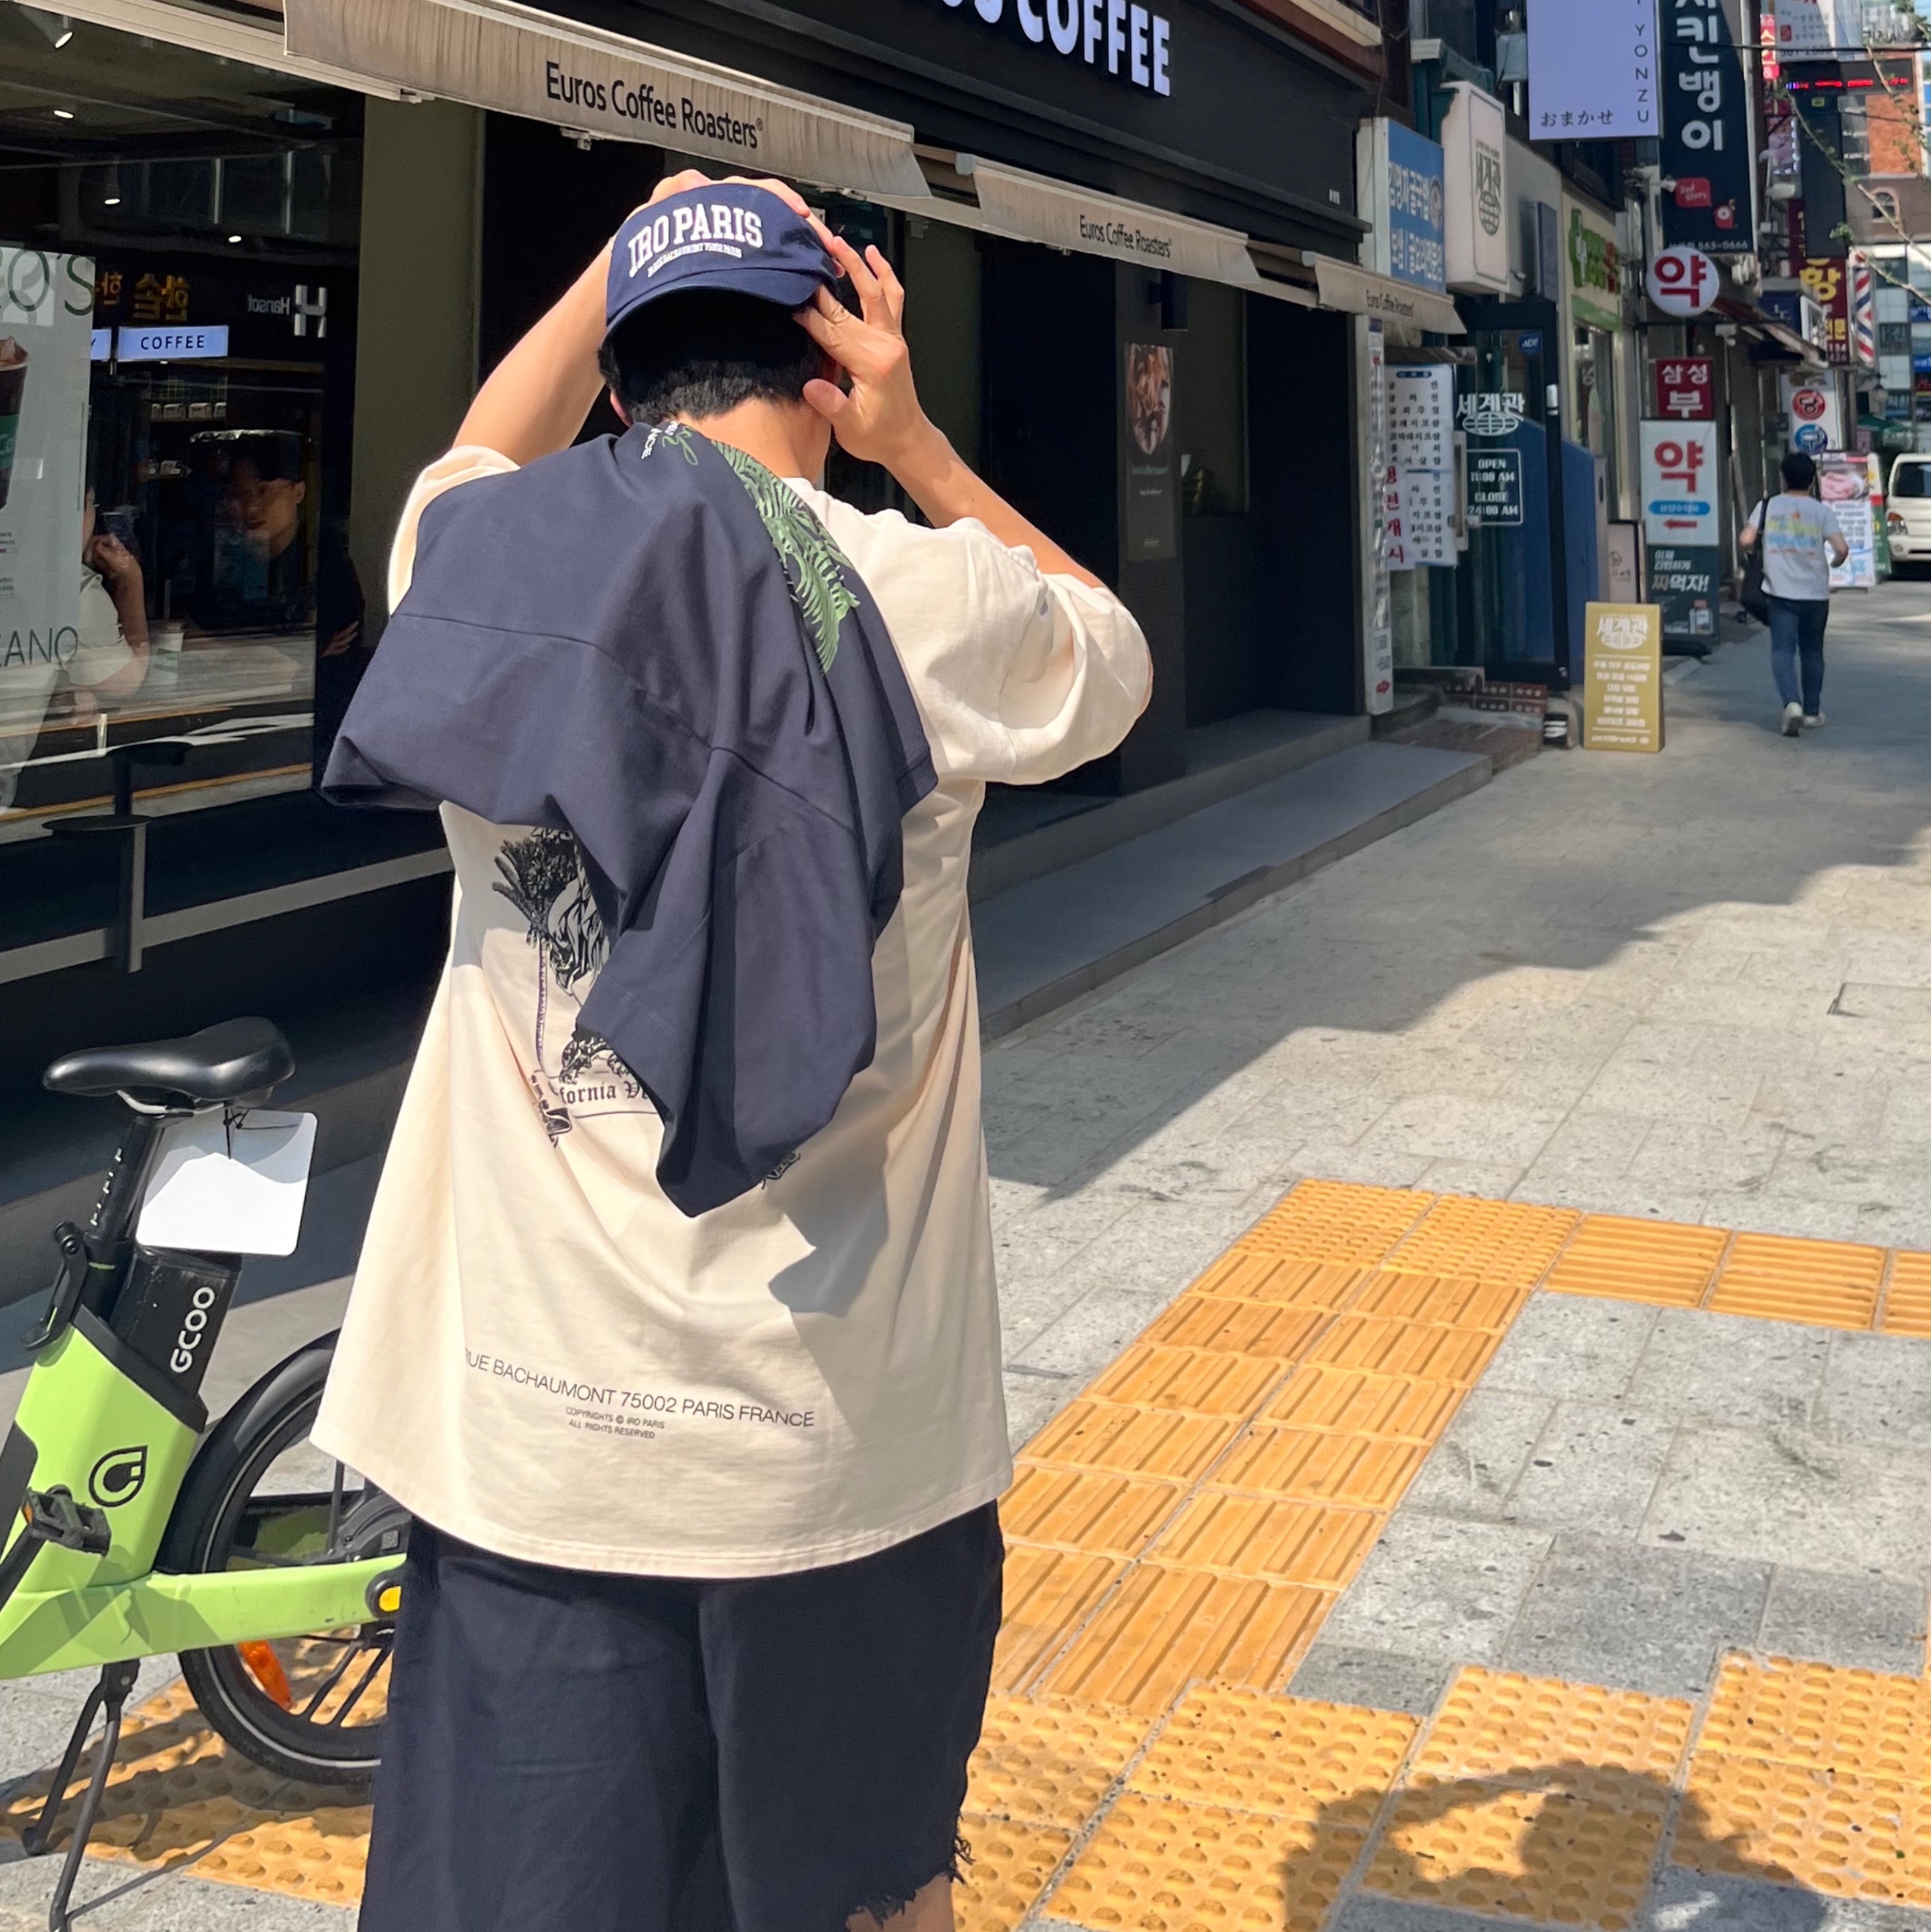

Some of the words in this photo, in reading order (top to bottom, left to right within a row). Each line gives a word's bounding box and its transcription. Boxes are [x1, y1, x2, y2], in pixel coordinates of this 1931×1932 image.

[1675, 0, 1723, 151] 킨뱅이
[546, 61, 606, 111] Euros
[611, 80, 676, 128] Coffee
[1540, 110, 1614, 127] おまかせ
[627, 215, 669, 278] IRO
[673, 204, 763, 249] PARIS
[1080, 214, 1104, 243] Euros
[1106, 222, 1134, 250] Coffee
[0, 248, 95, 316] O'S
[1654, 256, 1707, 308] 약
[140, 335, 206, 350] COFFEE
[1661, 364, 1708, 385] 삼성
[1456, 393, 1525, 421] 세계관
[1667, 390, 1704, 418] 부
[1478, 459, 1507, 468] OPEN
[1498, 471, 1515, 481] AM
[1654, 440, 1704, 493] 약
[1475, 491, 1509, 502] CLOSE
[1500, 505, 1518, 515] AM
[0, 625, 79, 668] ANO
[170, 1286, 216, 1374] GCOO
[493, 1359, 617, 1406] BACHAUMONT
[621, 1392, 676, 1414] 75002
[682, 1399, 735, 1421] PARIS
[739, 1405, 814, 1428] FRANCE
[566, 1406, 613, 1423] COPYRIGHTS
[627, 1416, 641, 1426] IRO
[642, 1418, 665, 1429] PARIS
[569, 1419, 582, 1429] ALL
[584, 1422, 613, 1434] RIGHTS
[614, 1426, 655, 1439] RESERVED
